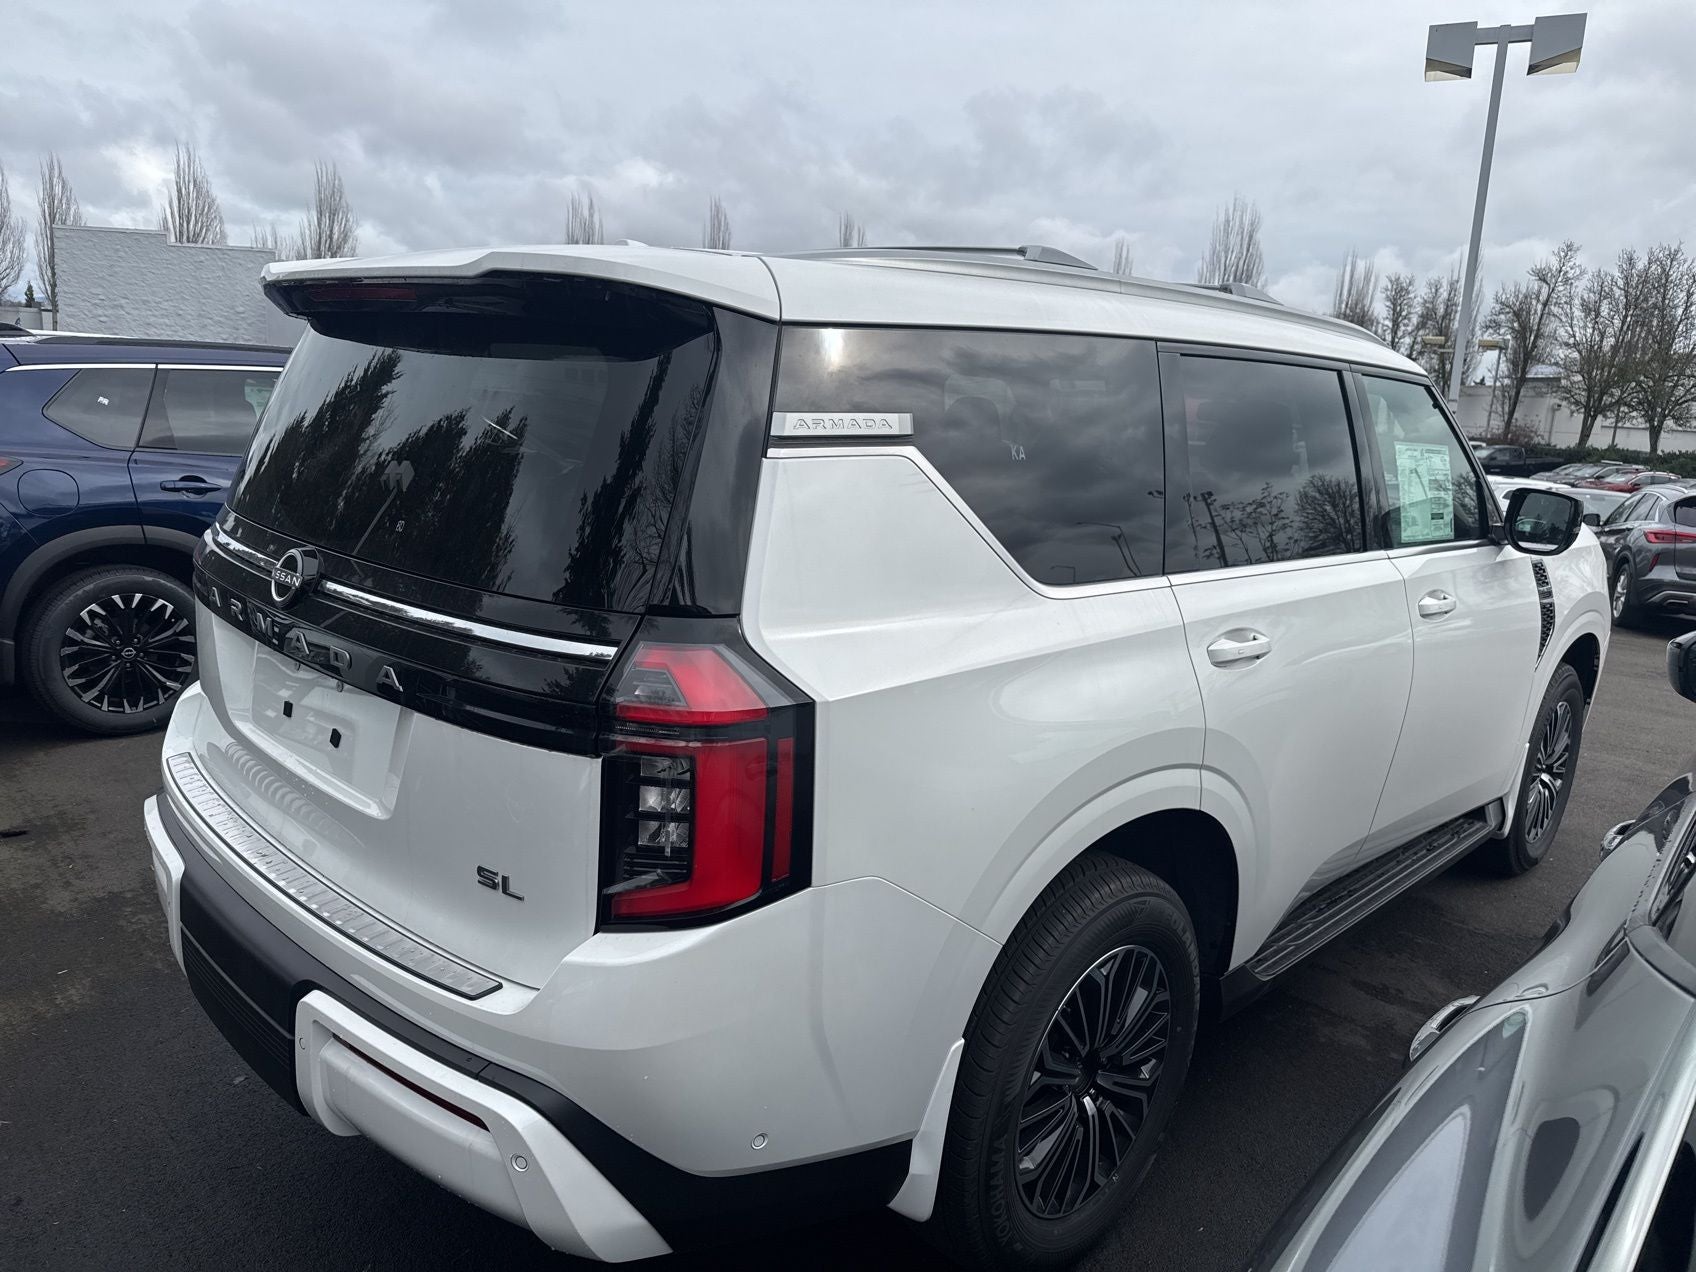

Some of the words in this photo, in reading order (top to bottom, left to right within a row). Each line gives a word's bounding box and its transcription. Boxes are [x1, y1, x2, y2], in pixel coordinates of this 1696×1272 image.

[793, 418, 893, 429] ARMADA
[275, 570, 301, 587] SSAN
[208, 586, 404, 693] ARMADA
[477, 865, 525, 901] SL
[989, 1134, 1013, 1247] YOKOHAMA
